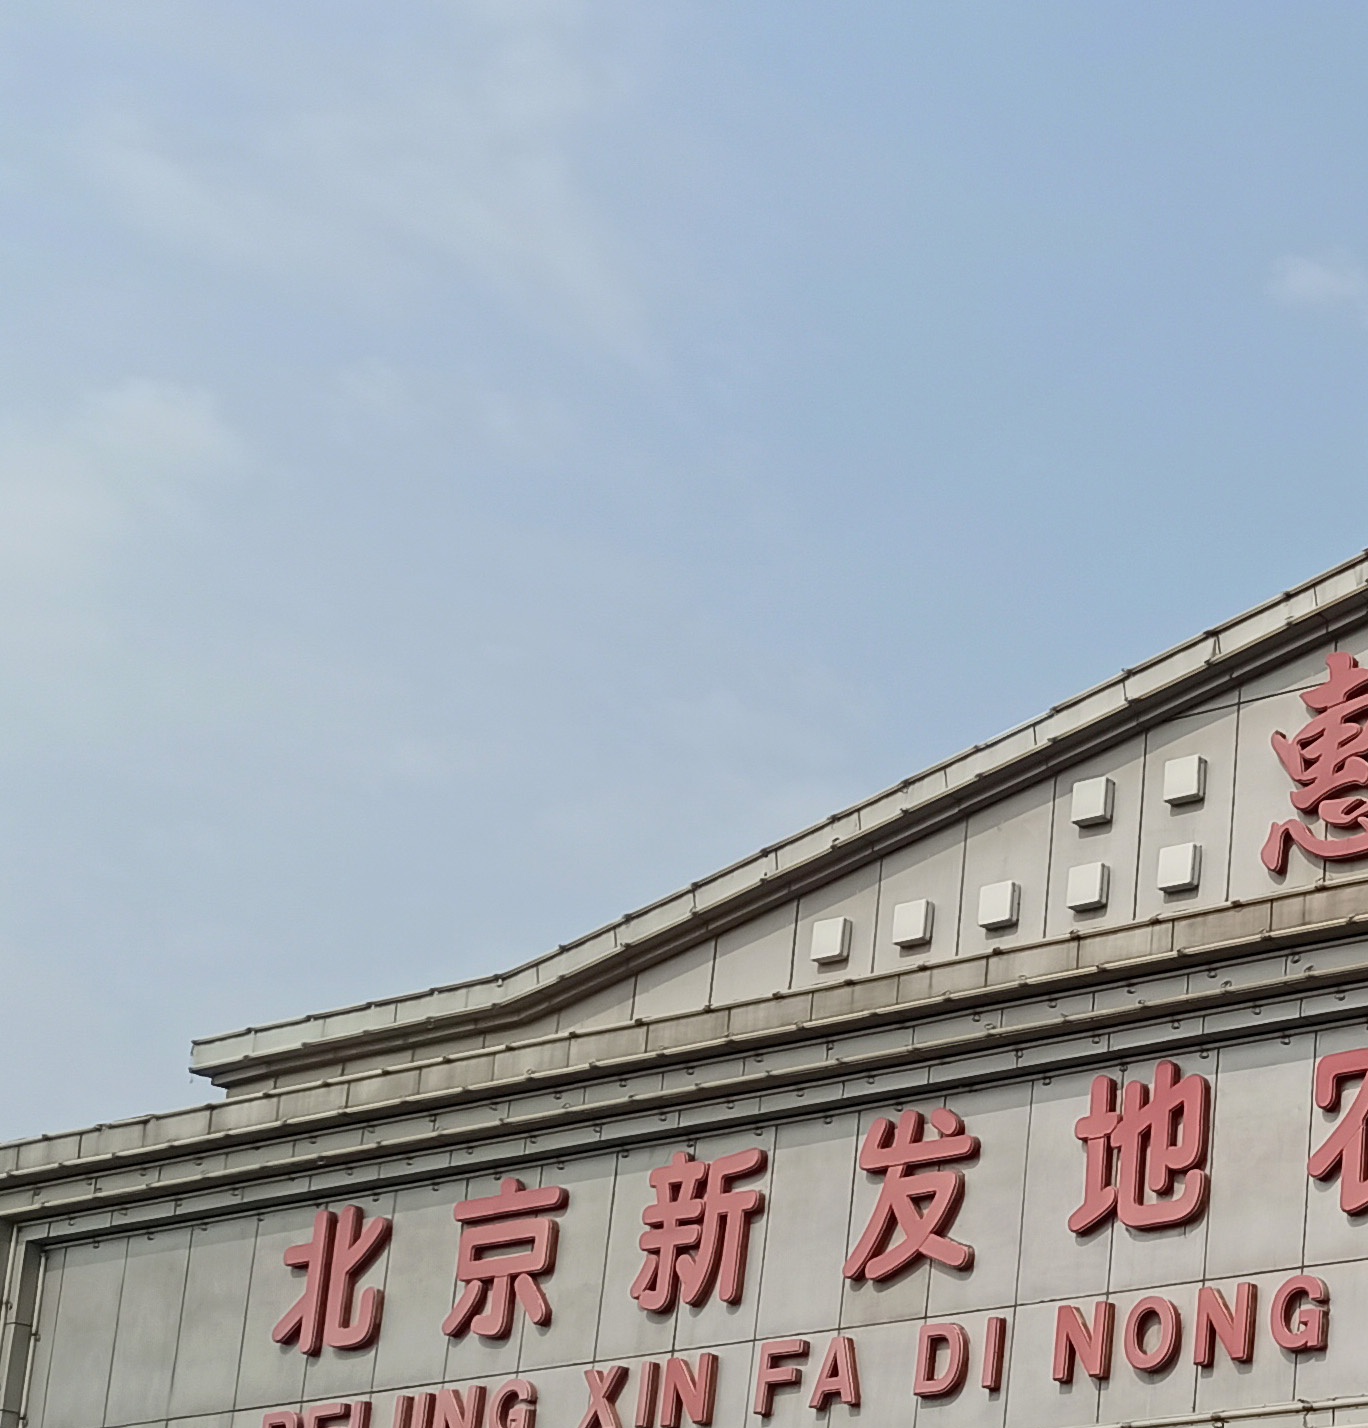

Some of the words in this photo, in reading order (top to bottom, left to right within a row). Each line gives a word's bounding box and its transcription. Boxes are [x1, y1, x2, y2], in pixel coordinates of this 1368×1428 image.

[753, 1336, 861, 1417] FA
[913, 1317, 1007, 1397] DI
[1053, 1273, 1329, 1383] NONG
